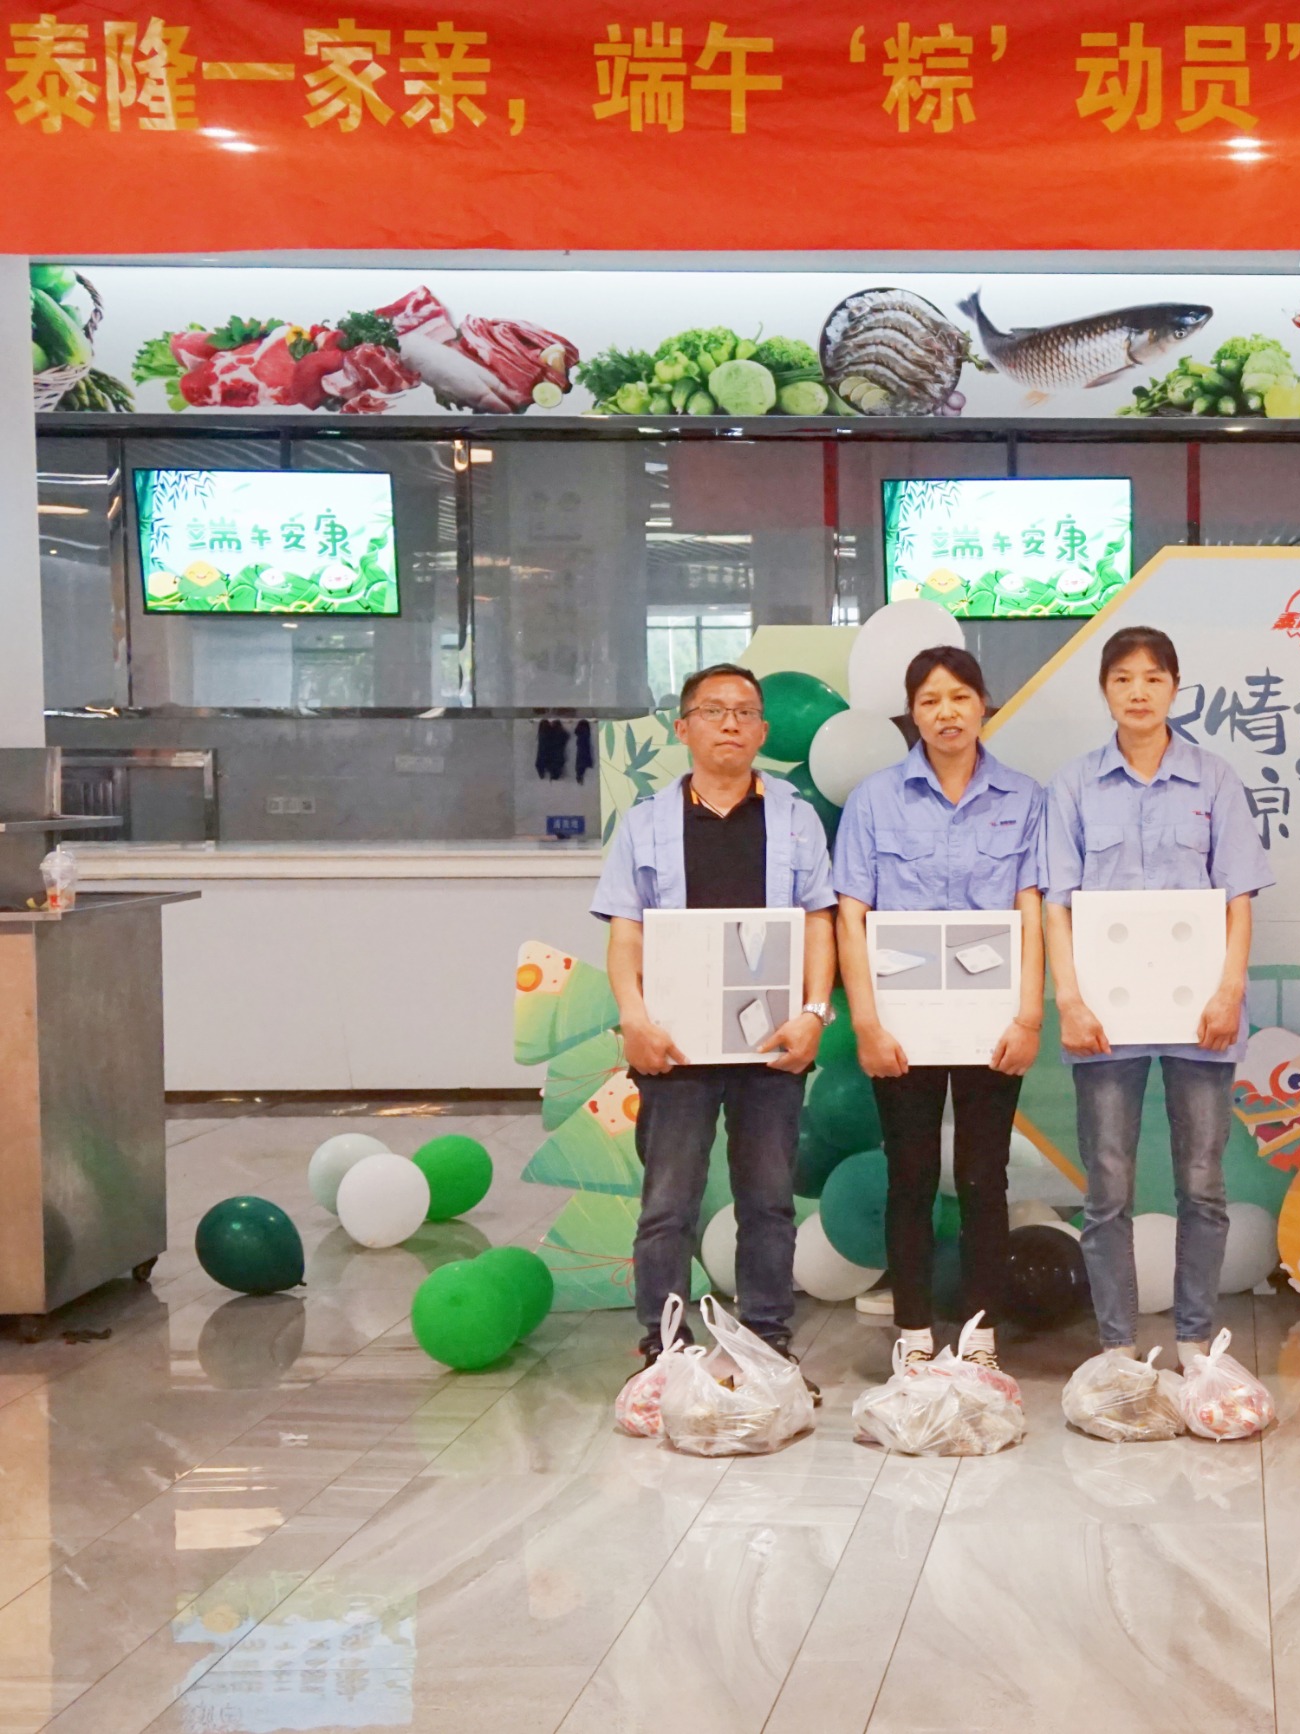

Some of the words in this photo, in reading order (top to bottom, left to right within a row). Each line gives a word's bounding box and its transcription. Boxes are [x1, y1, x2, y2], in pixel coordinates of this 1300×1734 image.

[186, 508, 352, 557] 端午安康
[930, 513, 1089, 562] 端午安康
